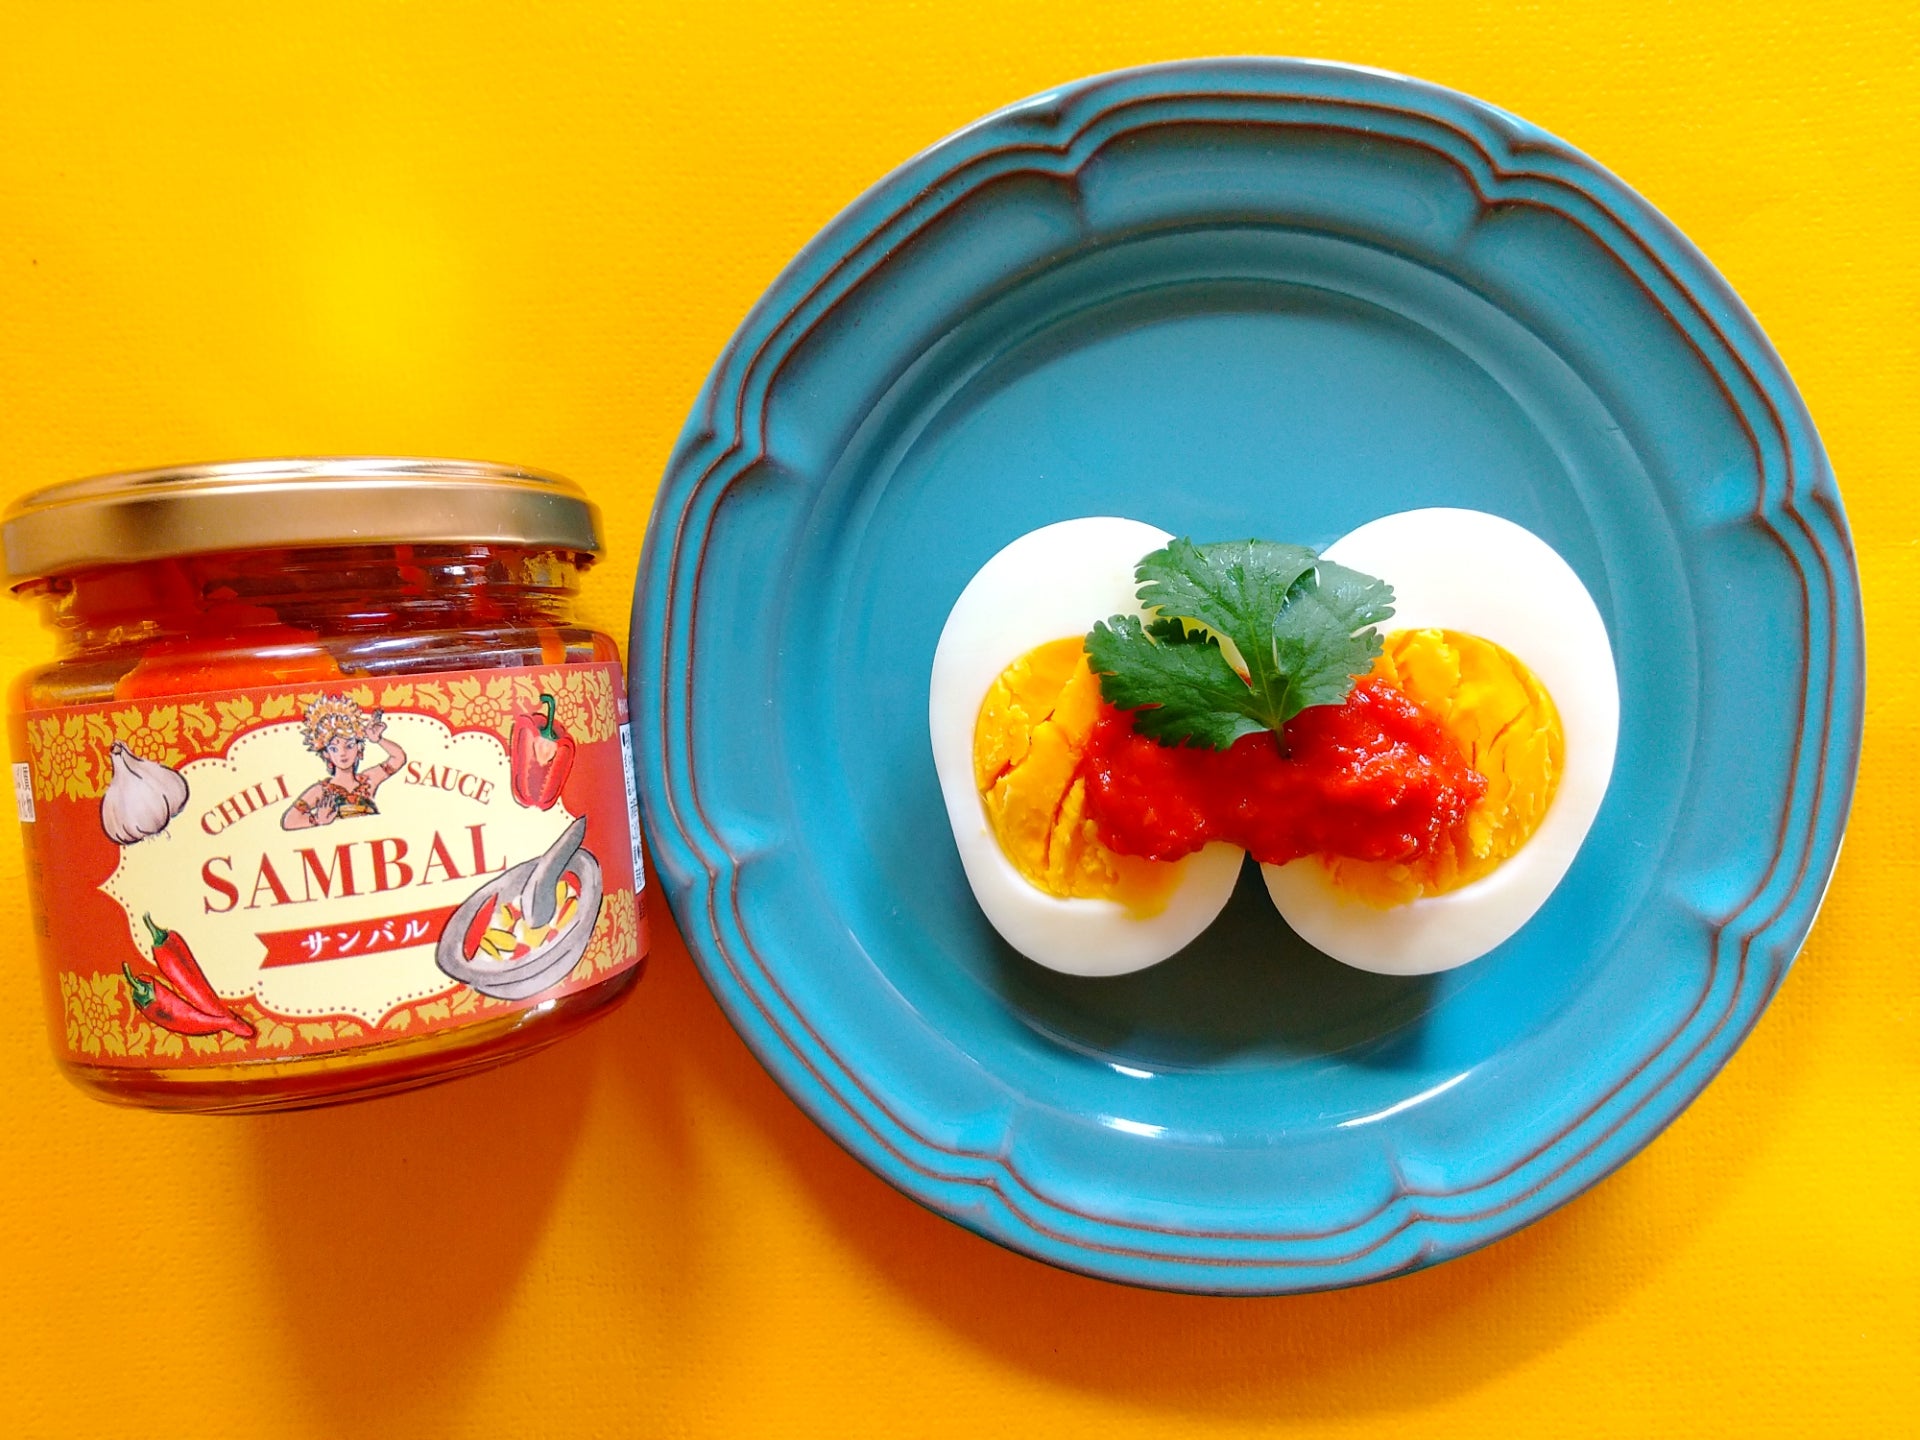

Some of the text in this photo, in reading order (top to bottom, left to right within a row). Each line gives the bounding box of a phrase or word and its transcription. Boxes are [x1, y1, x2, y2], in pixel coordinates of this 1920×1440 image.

[200, 760, 495, 836] CHILI SAUCE
[201, 823, 507, 915] SAMBAL
[301, 919, 430, 958] サンバル
